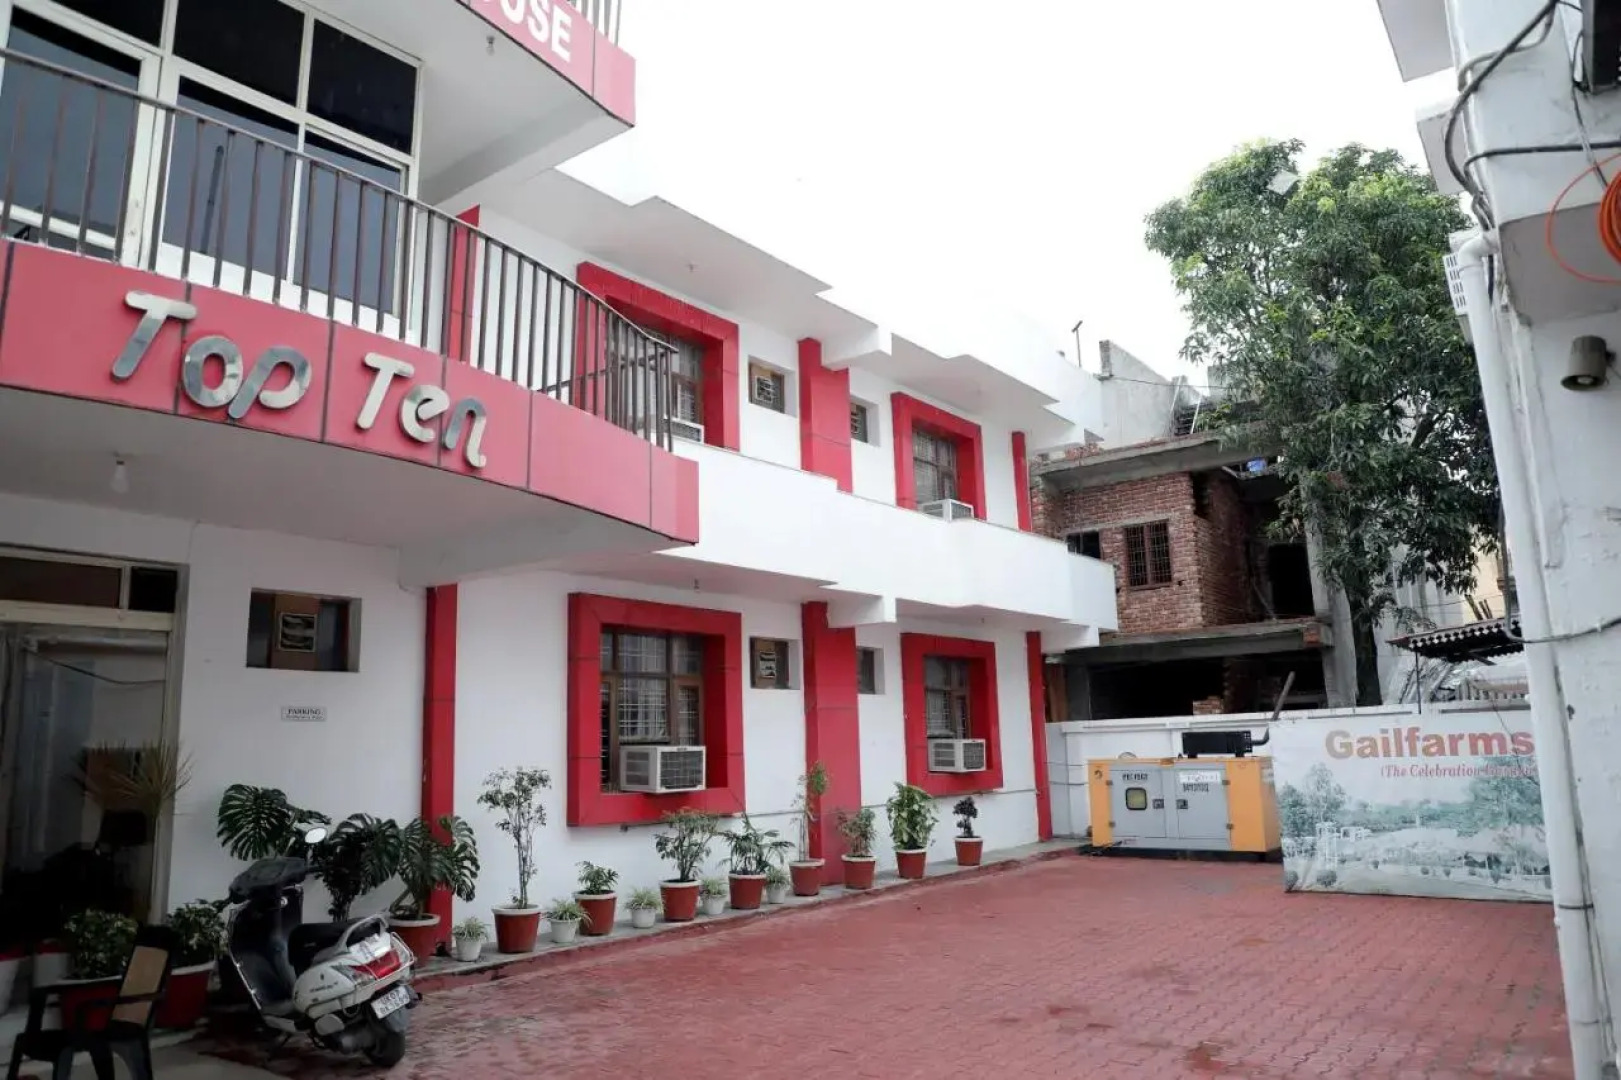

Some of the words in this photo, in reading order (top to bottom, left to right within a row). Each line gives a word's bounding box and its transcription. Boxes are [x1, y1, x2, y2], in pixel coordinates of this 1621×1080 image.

[111, 290, 312, 420] Top
[356, 352, 487, 469] Ten
[1325, 726, 1536, 760] Gailfarms
[1380, 764, 1407, 778] (The
[1410, 763, 1480, 778] Celebration
